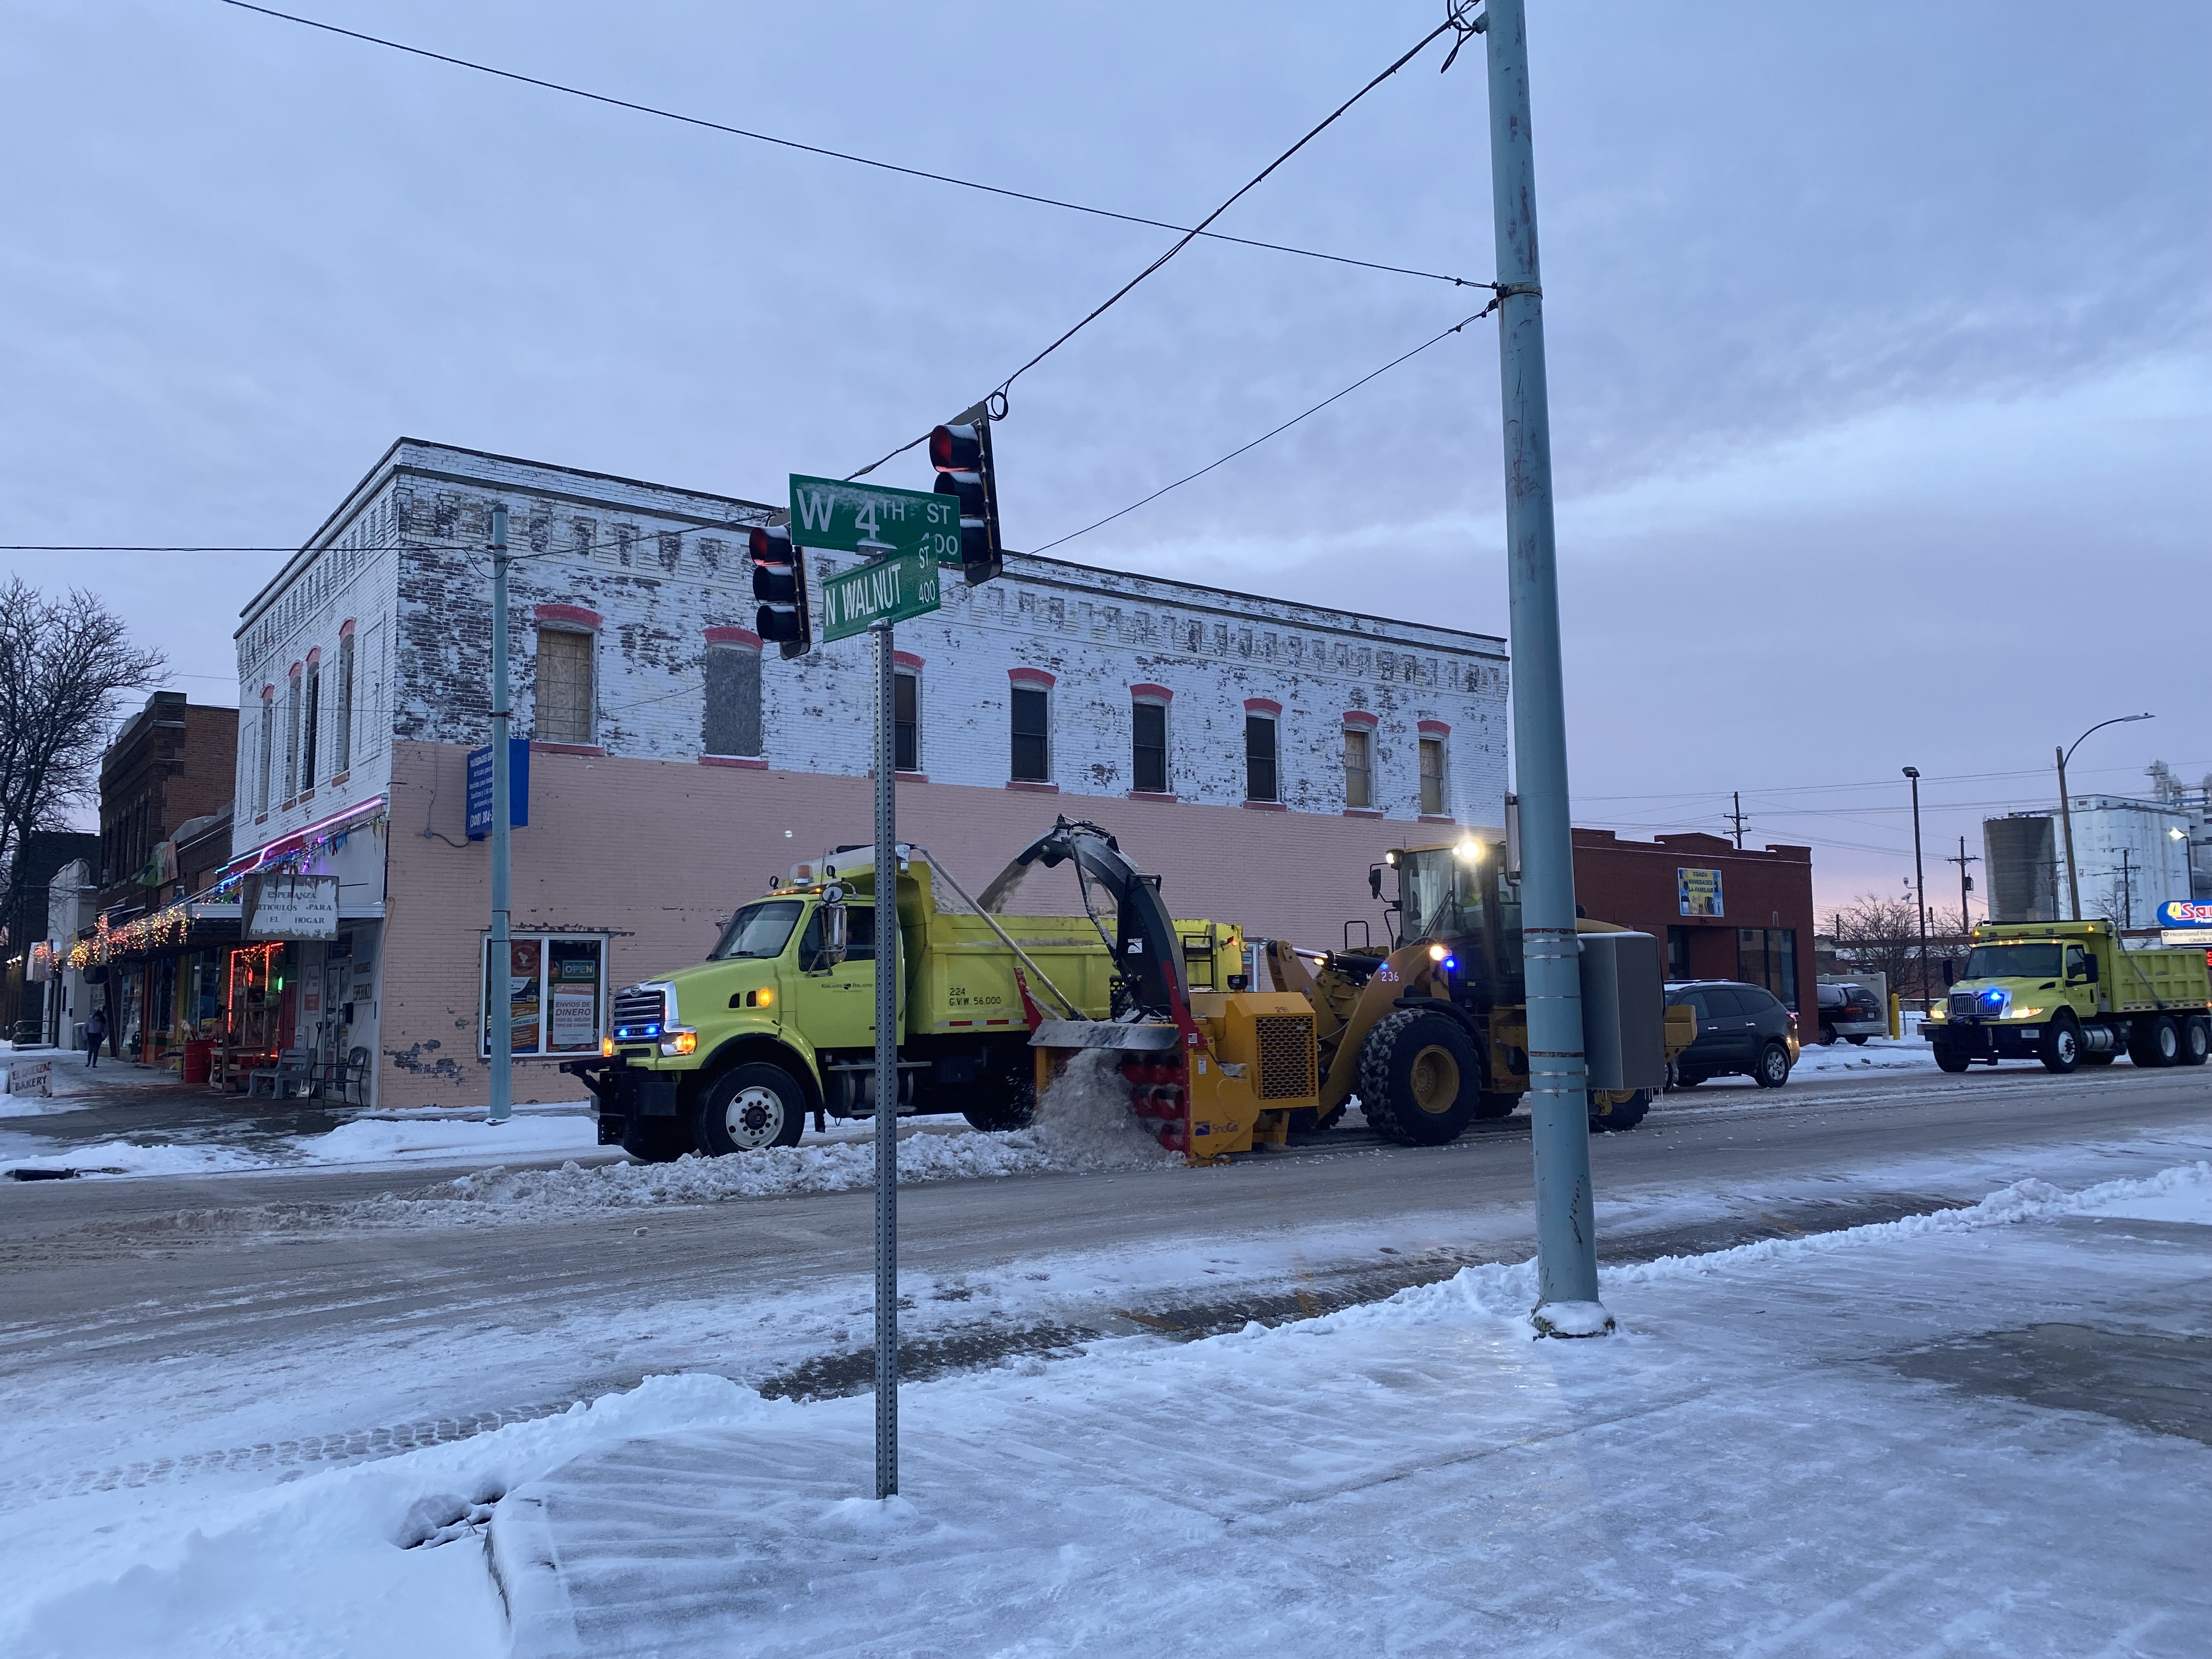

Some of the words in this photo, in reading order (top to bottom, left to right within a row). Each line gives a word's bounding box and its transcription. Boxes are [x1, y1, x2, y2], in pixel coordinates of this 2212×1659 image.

[796, 488, 835, 532] W
[855, 500, 905, 539] 4TH
[927, 503, 951, 524] ST
[919, 545, 929, 569] ST
[825, 589, 836, 627] N
[842, 563, 901, 621] WALNUT
[918, 580, 935, 604] 400
[565, 964, 593, 974] OPEN
[1381, 972, 1399, 982] 236
[15, 1075, 47, 1091] BAKERY
